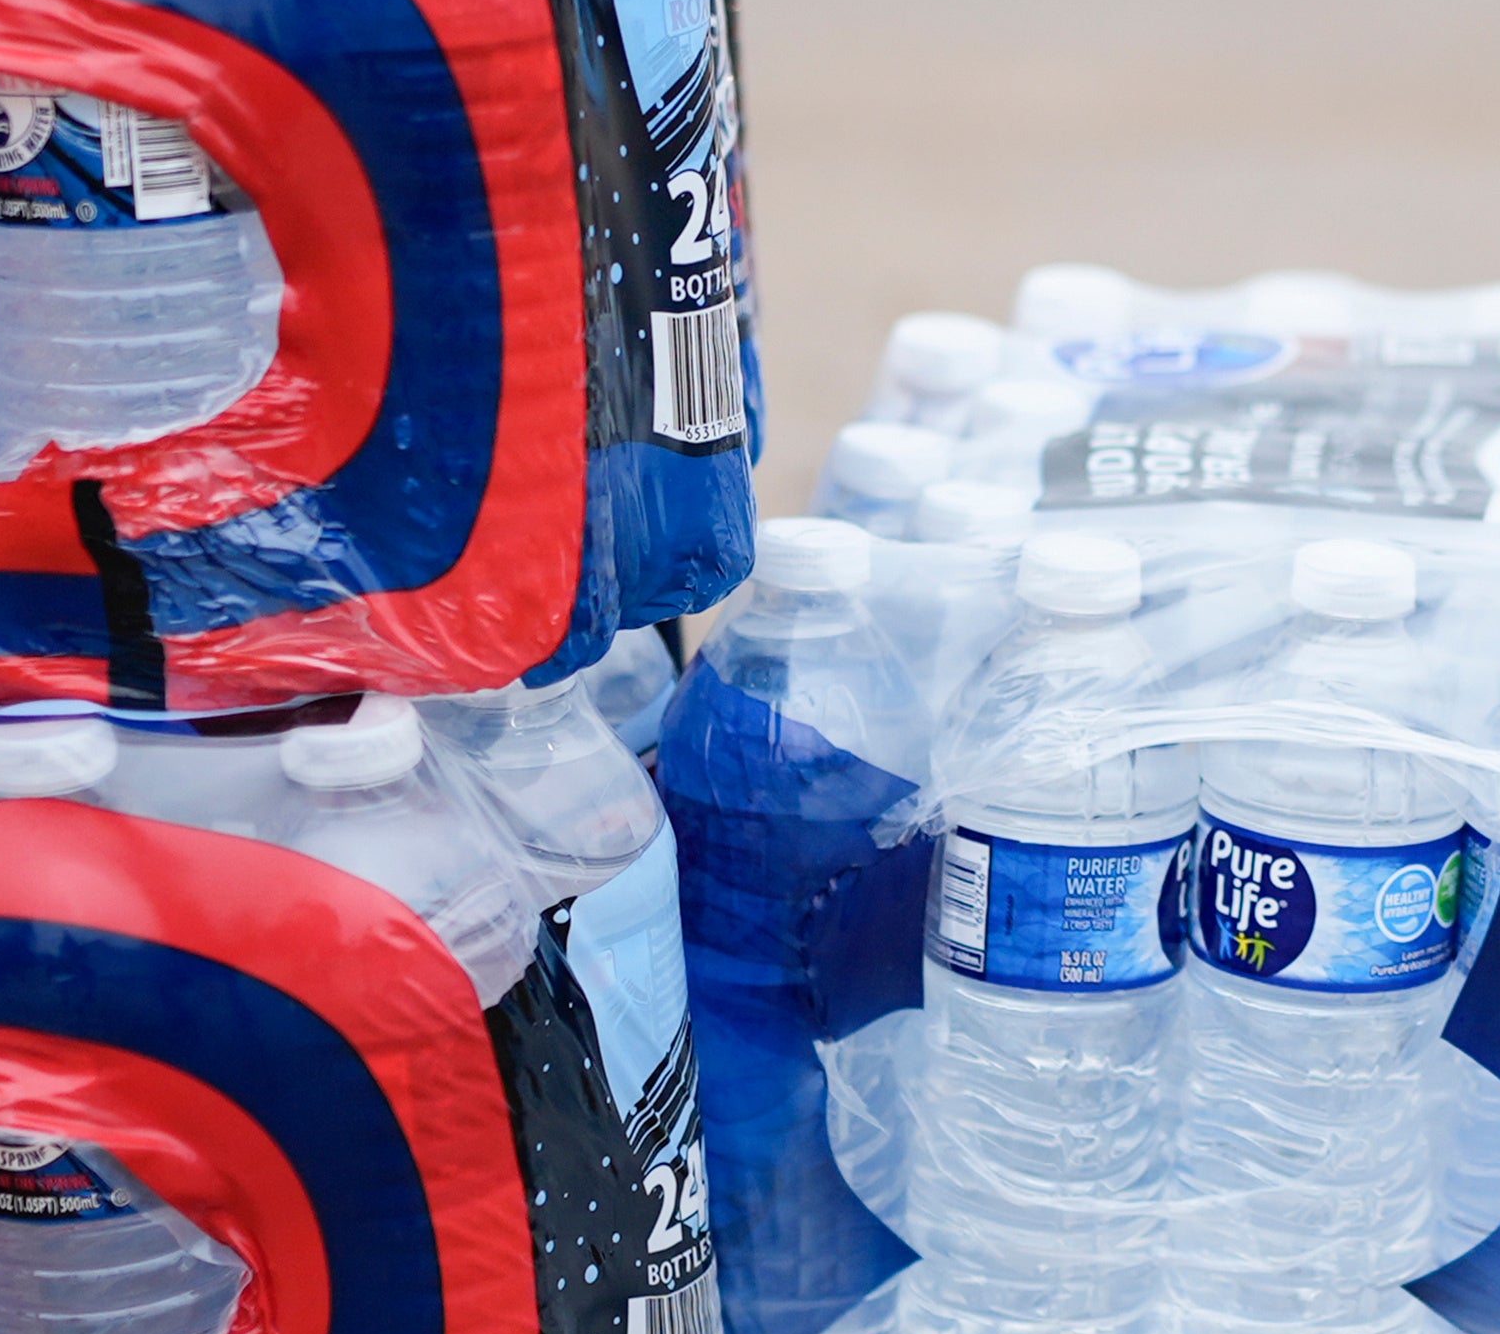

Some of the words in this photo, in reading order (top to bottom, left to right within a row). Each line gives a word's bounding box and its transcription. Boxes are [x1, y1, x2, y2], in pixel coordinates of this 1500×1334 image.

[25, 105, 50, 154] WATER
[667, 158, 732, 265] 24
[686, 422, 723, 441] 65317
[1067, 855, 1142, 877] PURIFIED
[1211, 829, 1297, 890] Pure
[1066, 877, 1127, 896] WATER
[1385, 887, 1431, 907] HEALTHY
[1215, 873, 1280, 931] Life
[1059, 968, 1082, 984] (500
[1083, 968, 1103, 983] mL)
[0, 1193, 14, 1211] OZ
[59, 1193, 100, 1213] 500mL
[642, 1134, 709, 1254] 24
